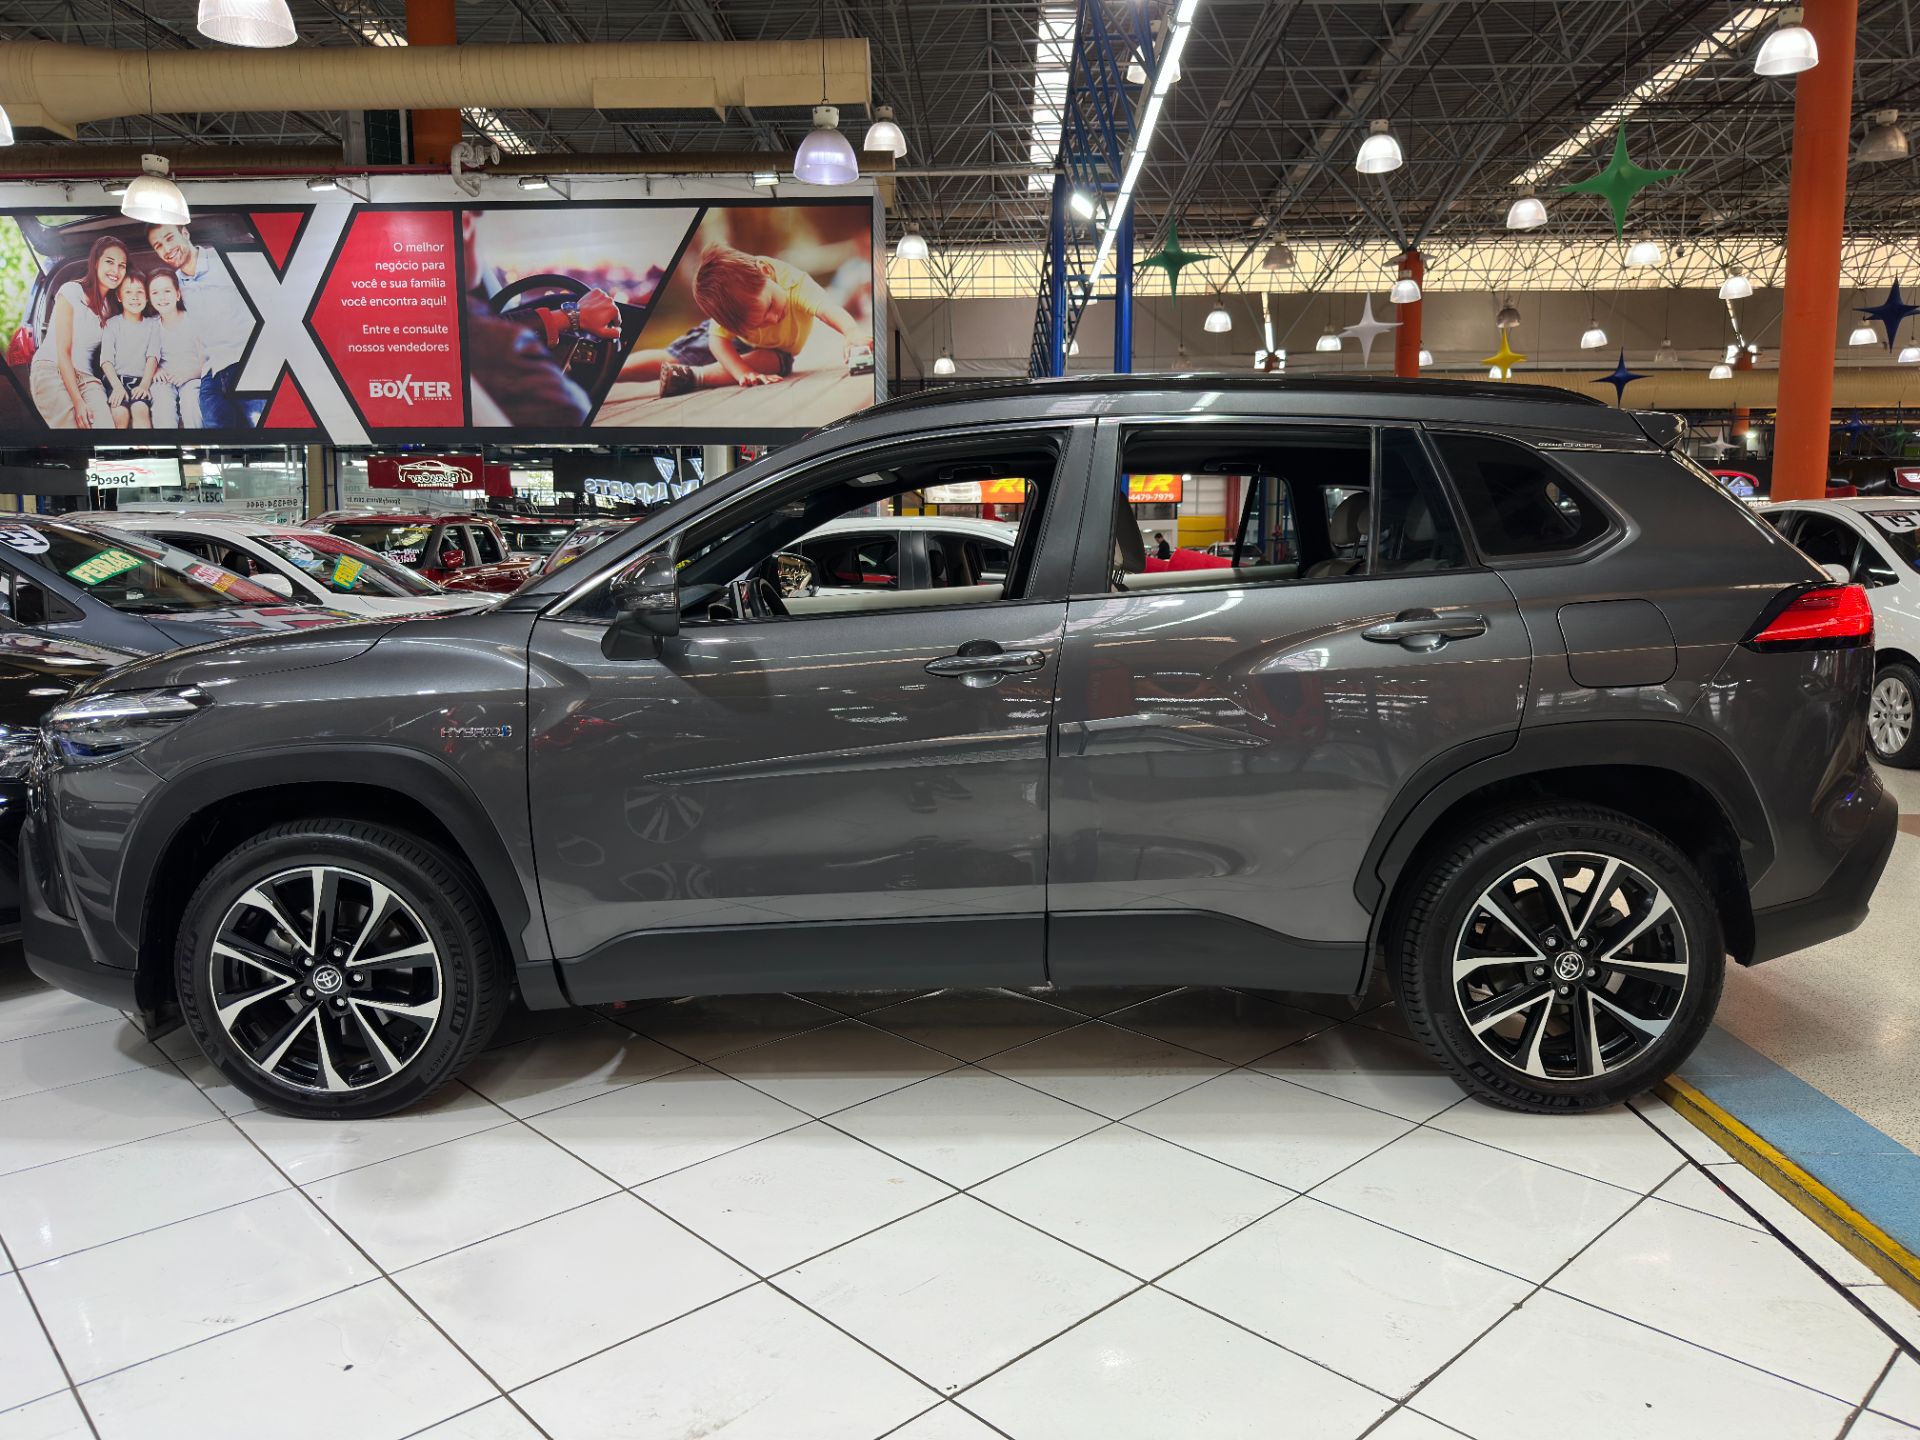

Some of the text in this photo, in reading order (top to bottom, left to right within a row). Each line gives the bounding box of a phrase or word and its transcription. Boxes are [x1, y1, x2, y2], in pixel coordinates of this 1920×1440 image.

[393, 242, 444, 252] O melhor
[375, 260, 445, 272] negócio para
[351, 277, 446, 289] você e sua família
[341, 296, 447, 308] você encontra aqui!
[362, 324, 449, 334] Entre e consulte
[348, 342, 450, 352] nossos vendedores
[369, 373, 452, 405] BOXTER
[441, 727, 500, 738] HYBRID
